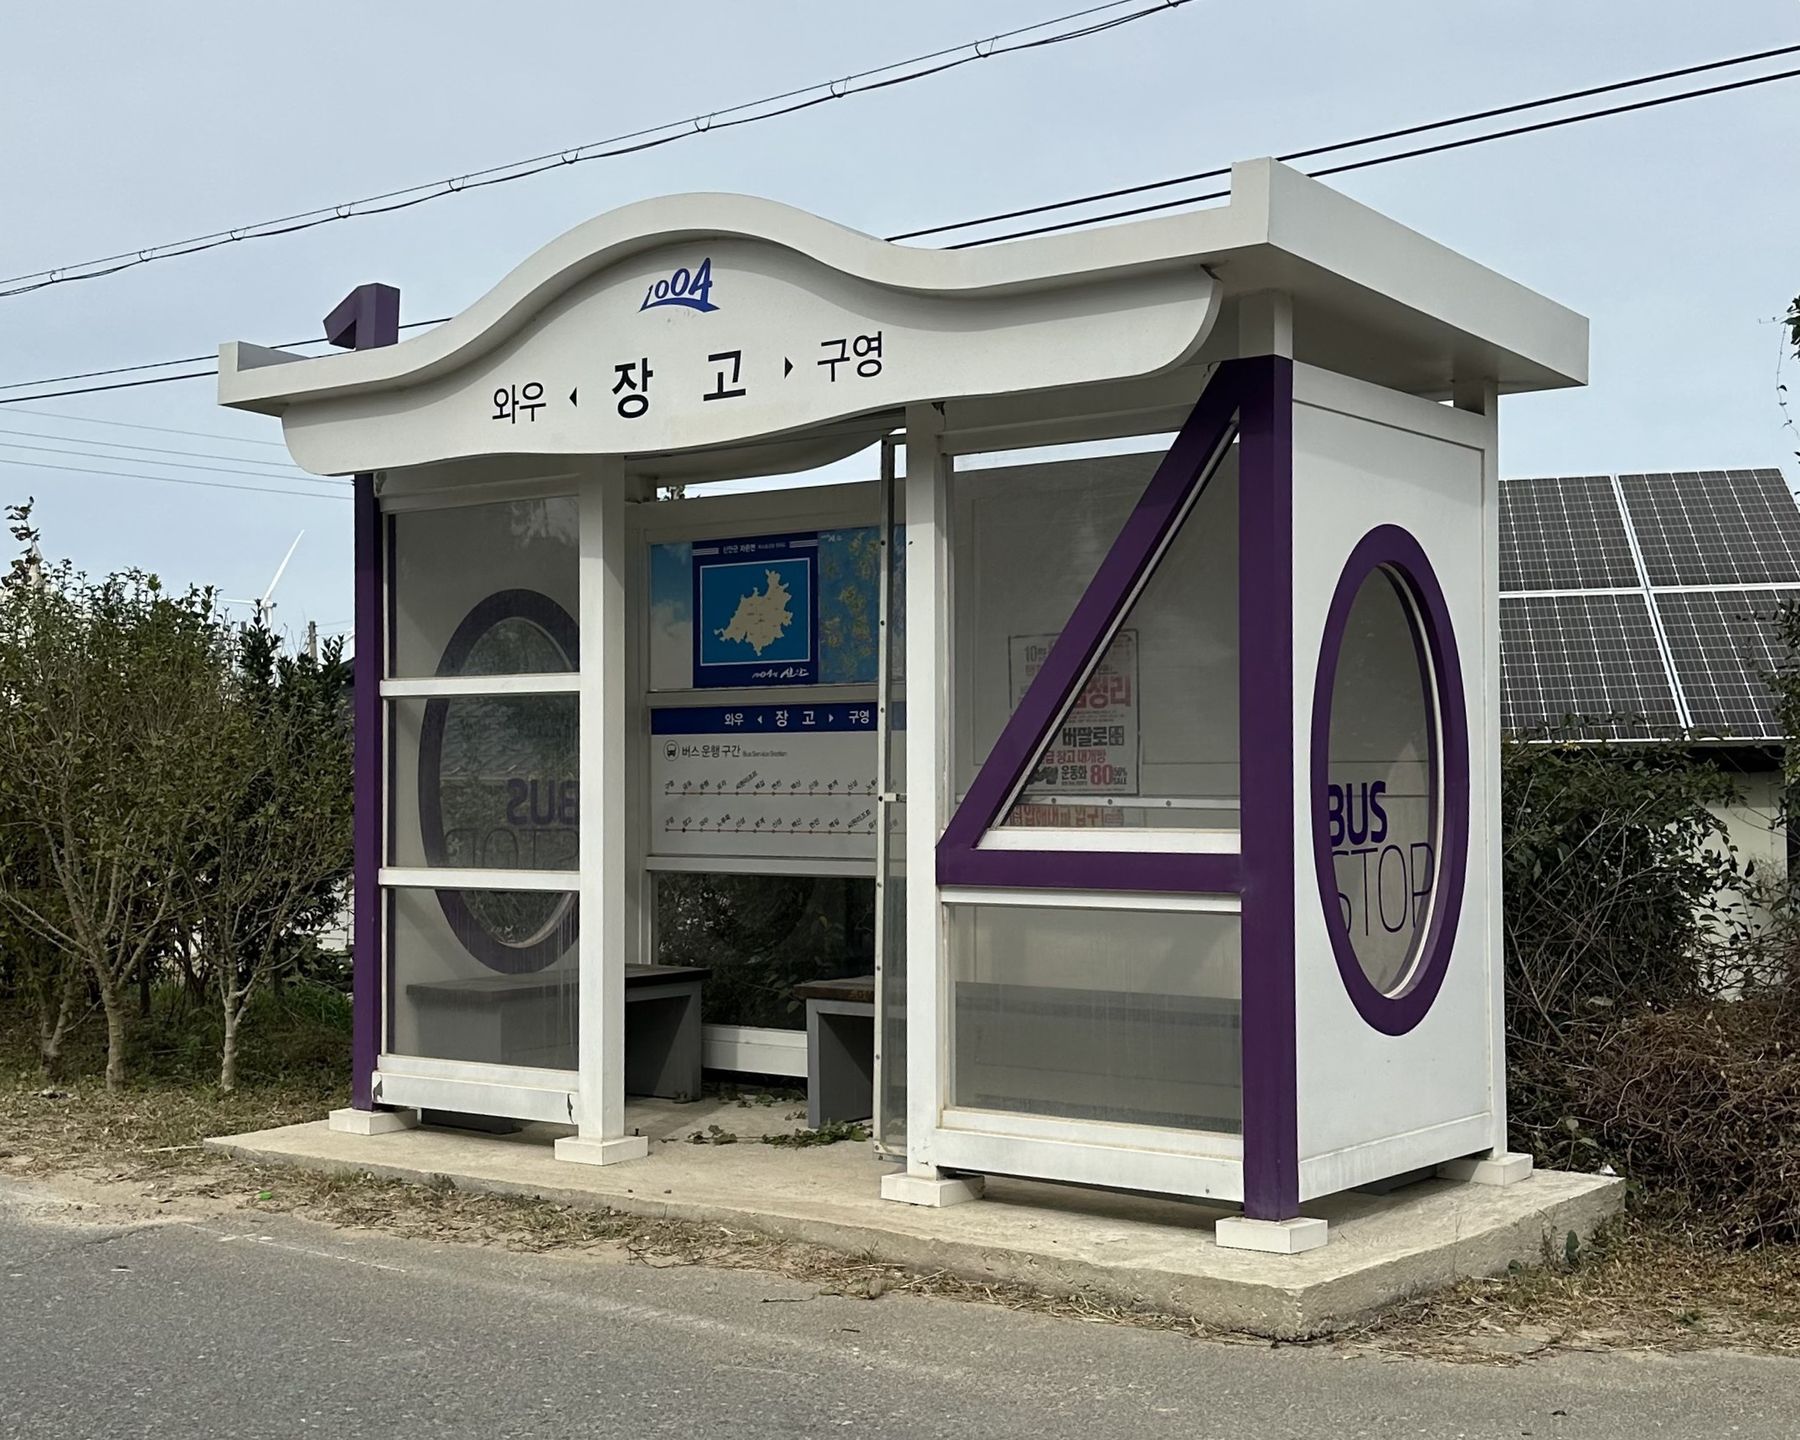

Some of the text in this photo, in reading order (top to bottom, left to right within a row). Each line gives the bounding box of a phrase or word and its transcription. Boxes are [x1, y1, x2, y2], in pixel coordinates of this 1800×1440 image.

[639, 257, 719, 312] 1004
[492, 381, 546, 424] 와우
[817, 331, 883, 382] 구영
[724, 713, 744, 726] 와우
[848, 710, 870, 725] 구영
[1062, 726, 1108, 748] 버팔로
[682, 746, 699, 757] 버스
[702, 745, 720, 758] 운행
[722, 745, 741, 757] 구간
[1061, 765, 1087, 780] 운동화
[1328, 780, 1388, 847] BUS
